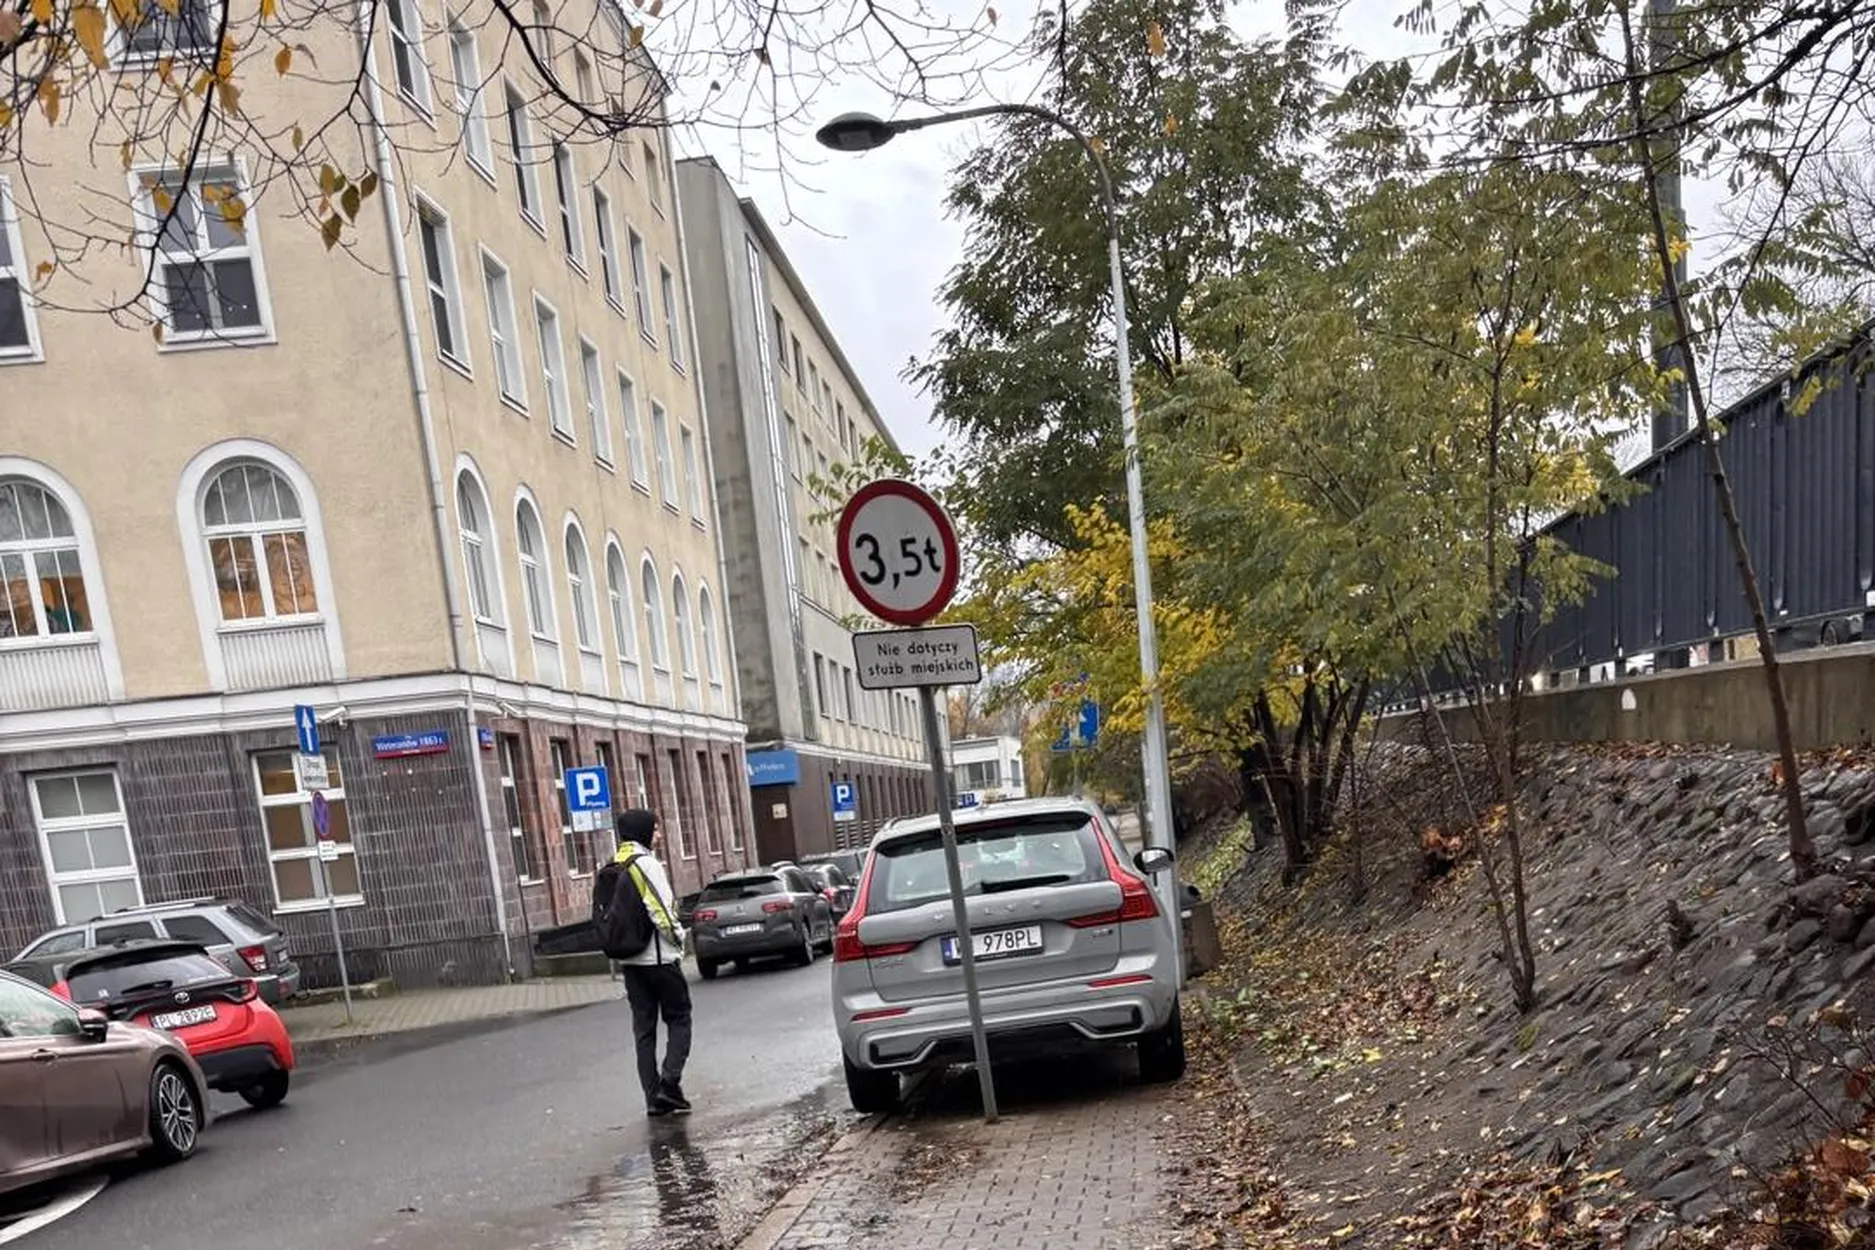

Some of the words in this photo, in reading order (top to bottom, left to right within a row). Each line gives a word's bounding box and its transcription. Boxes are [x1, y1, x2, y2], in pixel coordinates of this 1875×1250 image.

[856, 533, 941, 590] 3,5t
[877, 642, 900, 656] Nie
[907, 641, 958, 657] dotyczy
[868, 661, 904, 676] służb
[911, 658, 974, 675] miejskich
[576, 772, 600, 806] P
[836, 785, 850, 804] P
[983, 929, 1038, 953] 978PL
